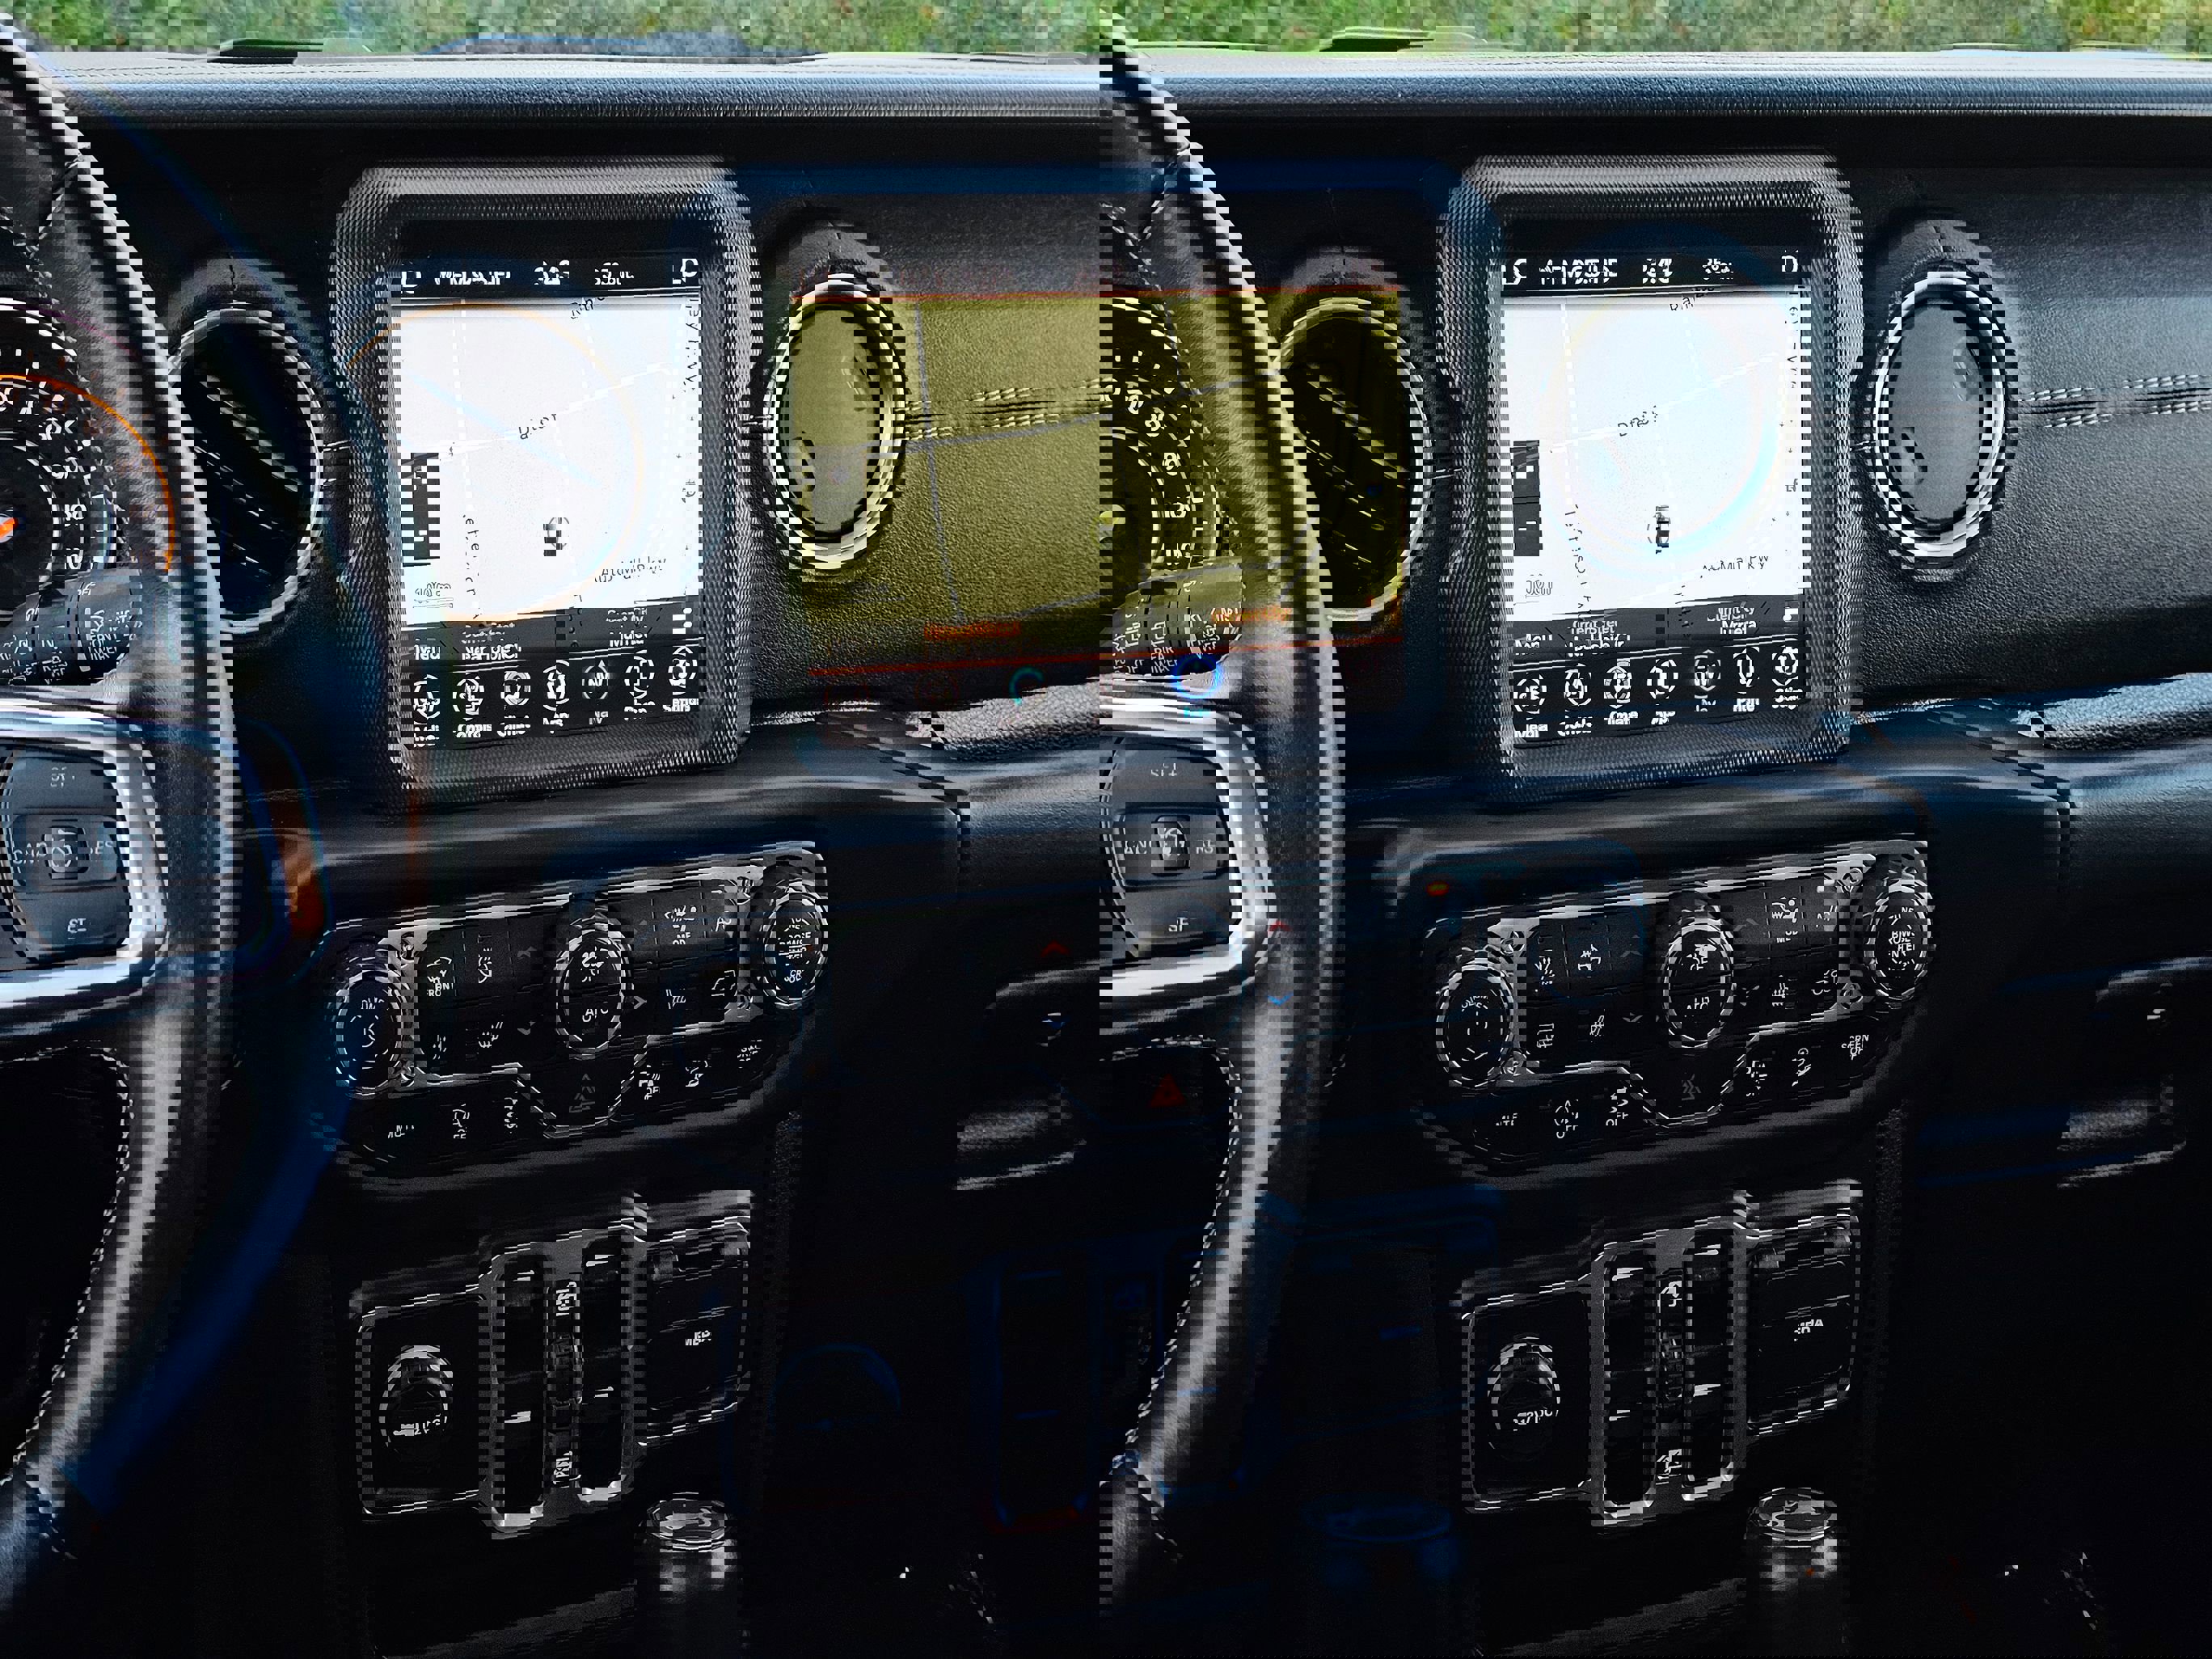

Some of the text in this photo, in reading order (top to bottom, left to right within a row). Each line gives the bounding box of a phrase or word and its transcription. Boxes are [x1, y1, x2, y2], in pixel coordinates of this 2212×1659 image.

[902, 264, 1015, 285] FM 95.5-HD
[1077, 260, 1130, 284] 3:43
[1354, 255, 1385, 278] LO
[802, 264, 836, 288] LO
[40, 395, 71, 416] 70
[84, 416, 114, 438] 80
[1036, 411, 1102, 437] Date St
[114, 456, 146, 477] 90
[129, 501, 165, 521] 100
[130, 547, 161, 566] 110
[928, 508, 955, 592] Jefferson
[1196, 556, 1327, 579] Auto Mall Pkwy
[163, 580, 188, 593] OFF
[842, 580, 872, 597] 100
[51, 605, 71, 618] ON
[225, 607, 258, 626] MIST
[1214, 607, 1291, 623] Current City
[179, 627, 222, 647] FRONT
[925, 622, 1020, 639] Current Street
[1230, 624, 1291, 642] Murrieta
[184, 641, 227, 660] WIPER
[829, 637, 881, 656] Menu
[927, 637, 1042, 658] Near Hobie Cir
[15, 660, 36, 672] PULL
[48, 660, 72, 676] OFF
[94, 661, 135, 679] WIPER
[1183, 670, 1211, 688] NW
[833, 690, 867, 707] 95.5
[1257, 699, 1302, 715] Phone
[1335, 693, 1390, 711] Settings
[1095, 710, 1133, 727] Apps
[1184, 705, 1212, 719] Nav
[910, 719, 973, 737] Controls
[1001, 715, 1057, 732] Climate
[828, 724, 876, 742] Media
[37, 842, 87, 858] CANC
[186, 840, 218, 855] RES
[1427, 910, 1456, 929] A/C
[1578, 913, 1604, 925] TUNE
[1349, 932, 1377, 944] MODE
[1568, 931, 1614, 946] BROWSE
[1574, 947, 1609, 960] ENTER
[1171, 961, 1200, 977] OFF
[1572, 964, 1609, 978] SCROLL
[861, 979, 896, 993] FRONT
[716, 996, 760, 1013] VOLUME
[1167, 1001, 1205, 1018] AUTO
[1478, 1038, 1520, 1053] SCREEN
[1488, 1050, 1509, 1062] OFF
[1290, 1085, 1313, 1097] OFF
[784, 1118, 821, 1133] MUTE
[1010, 1117, 1034, 1129] OFF
[909, 1126, 933, 1139] OFF
[1379, 1323, 1423, 1341] MEDIA
[834, 1412, 881, 1429] 12V DC
